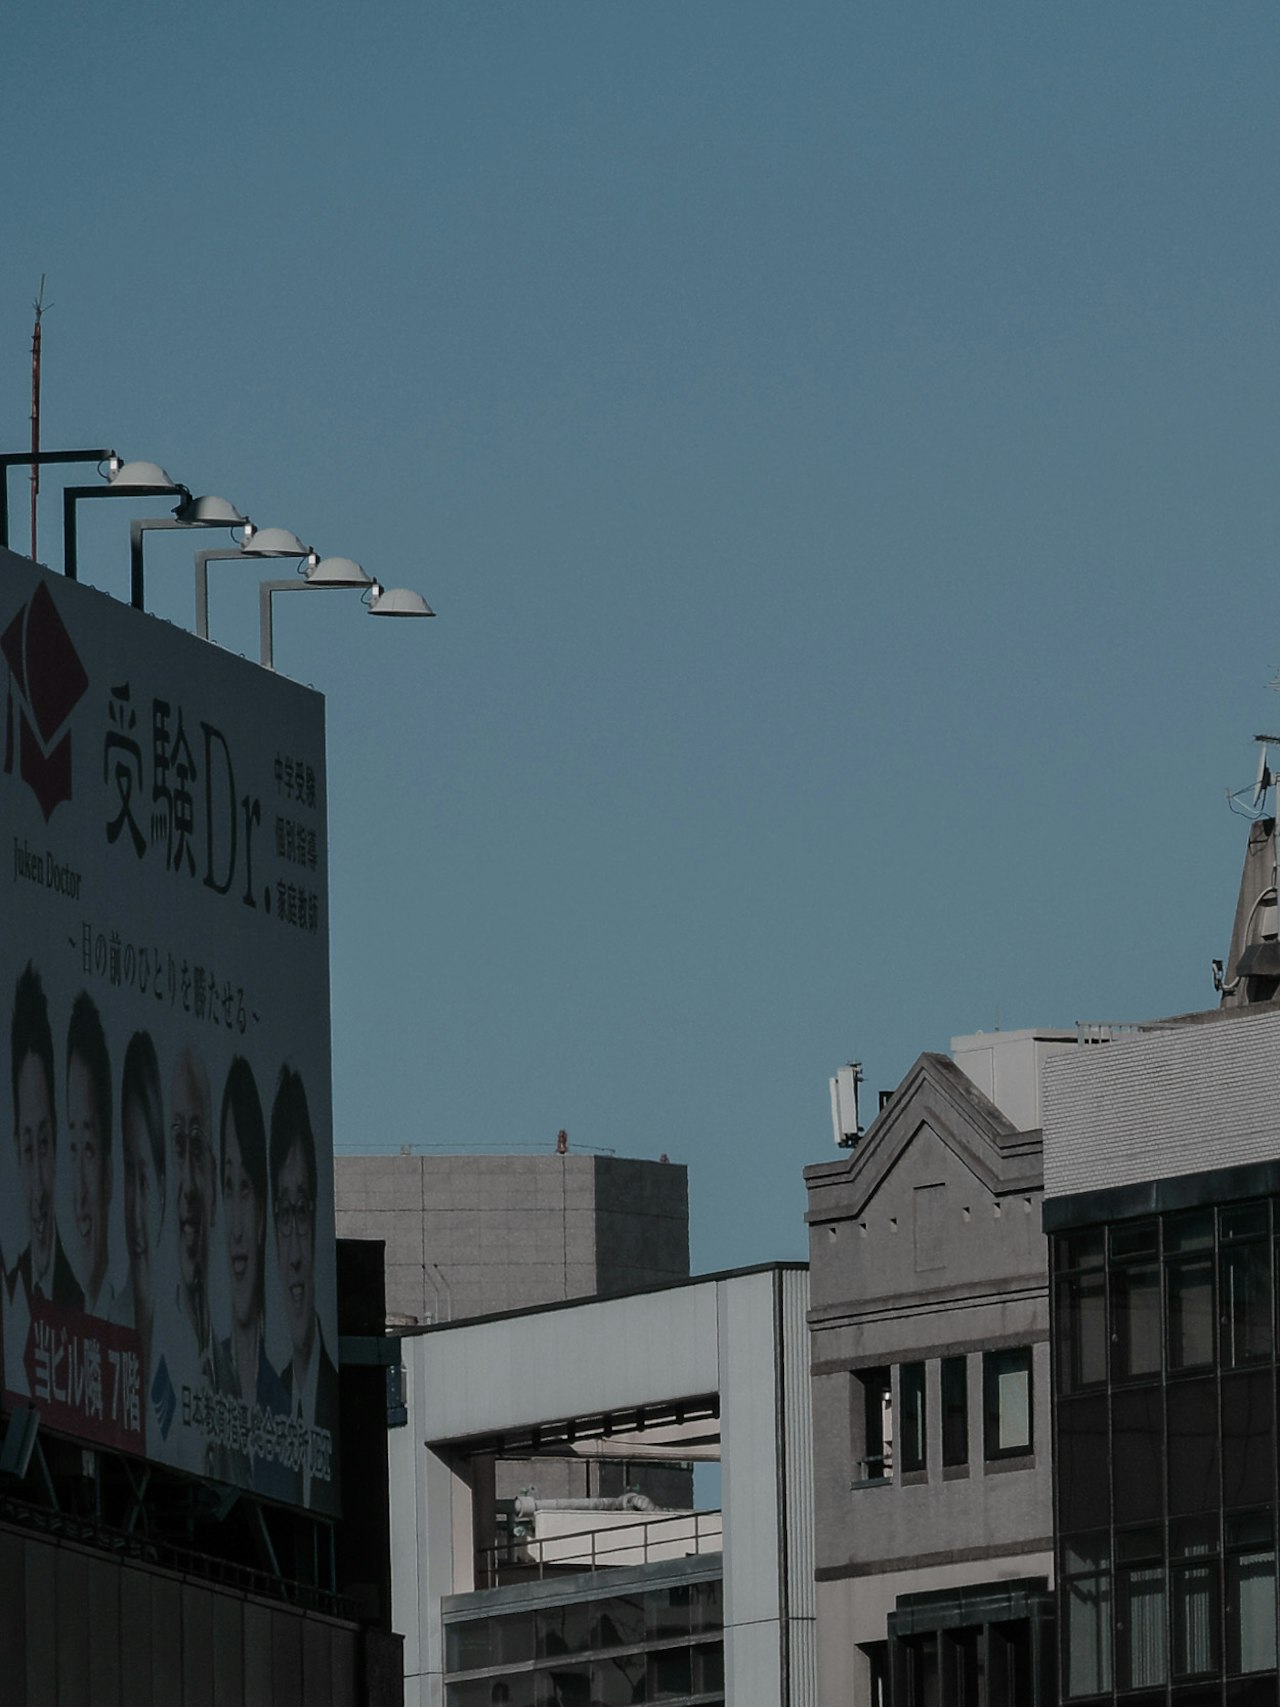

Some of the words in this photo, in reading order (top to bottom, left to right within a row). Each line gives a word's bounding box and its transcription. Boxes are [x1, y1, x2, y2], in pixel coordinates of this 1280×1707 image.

[105, 681, 272, 914] 受験Dr.
[273, 751, 317, 810] 中学受験
[13, 836, 45, 886] Juken
[46, 851, 82, 901] Doctor
[275, 815, 318, 872] 個別指導
[276, 877, 318, 935] 家庭教師
[34, 1319, 103, 1421] 当ビル隣
[107, 1348, 141, 1433] 7階
